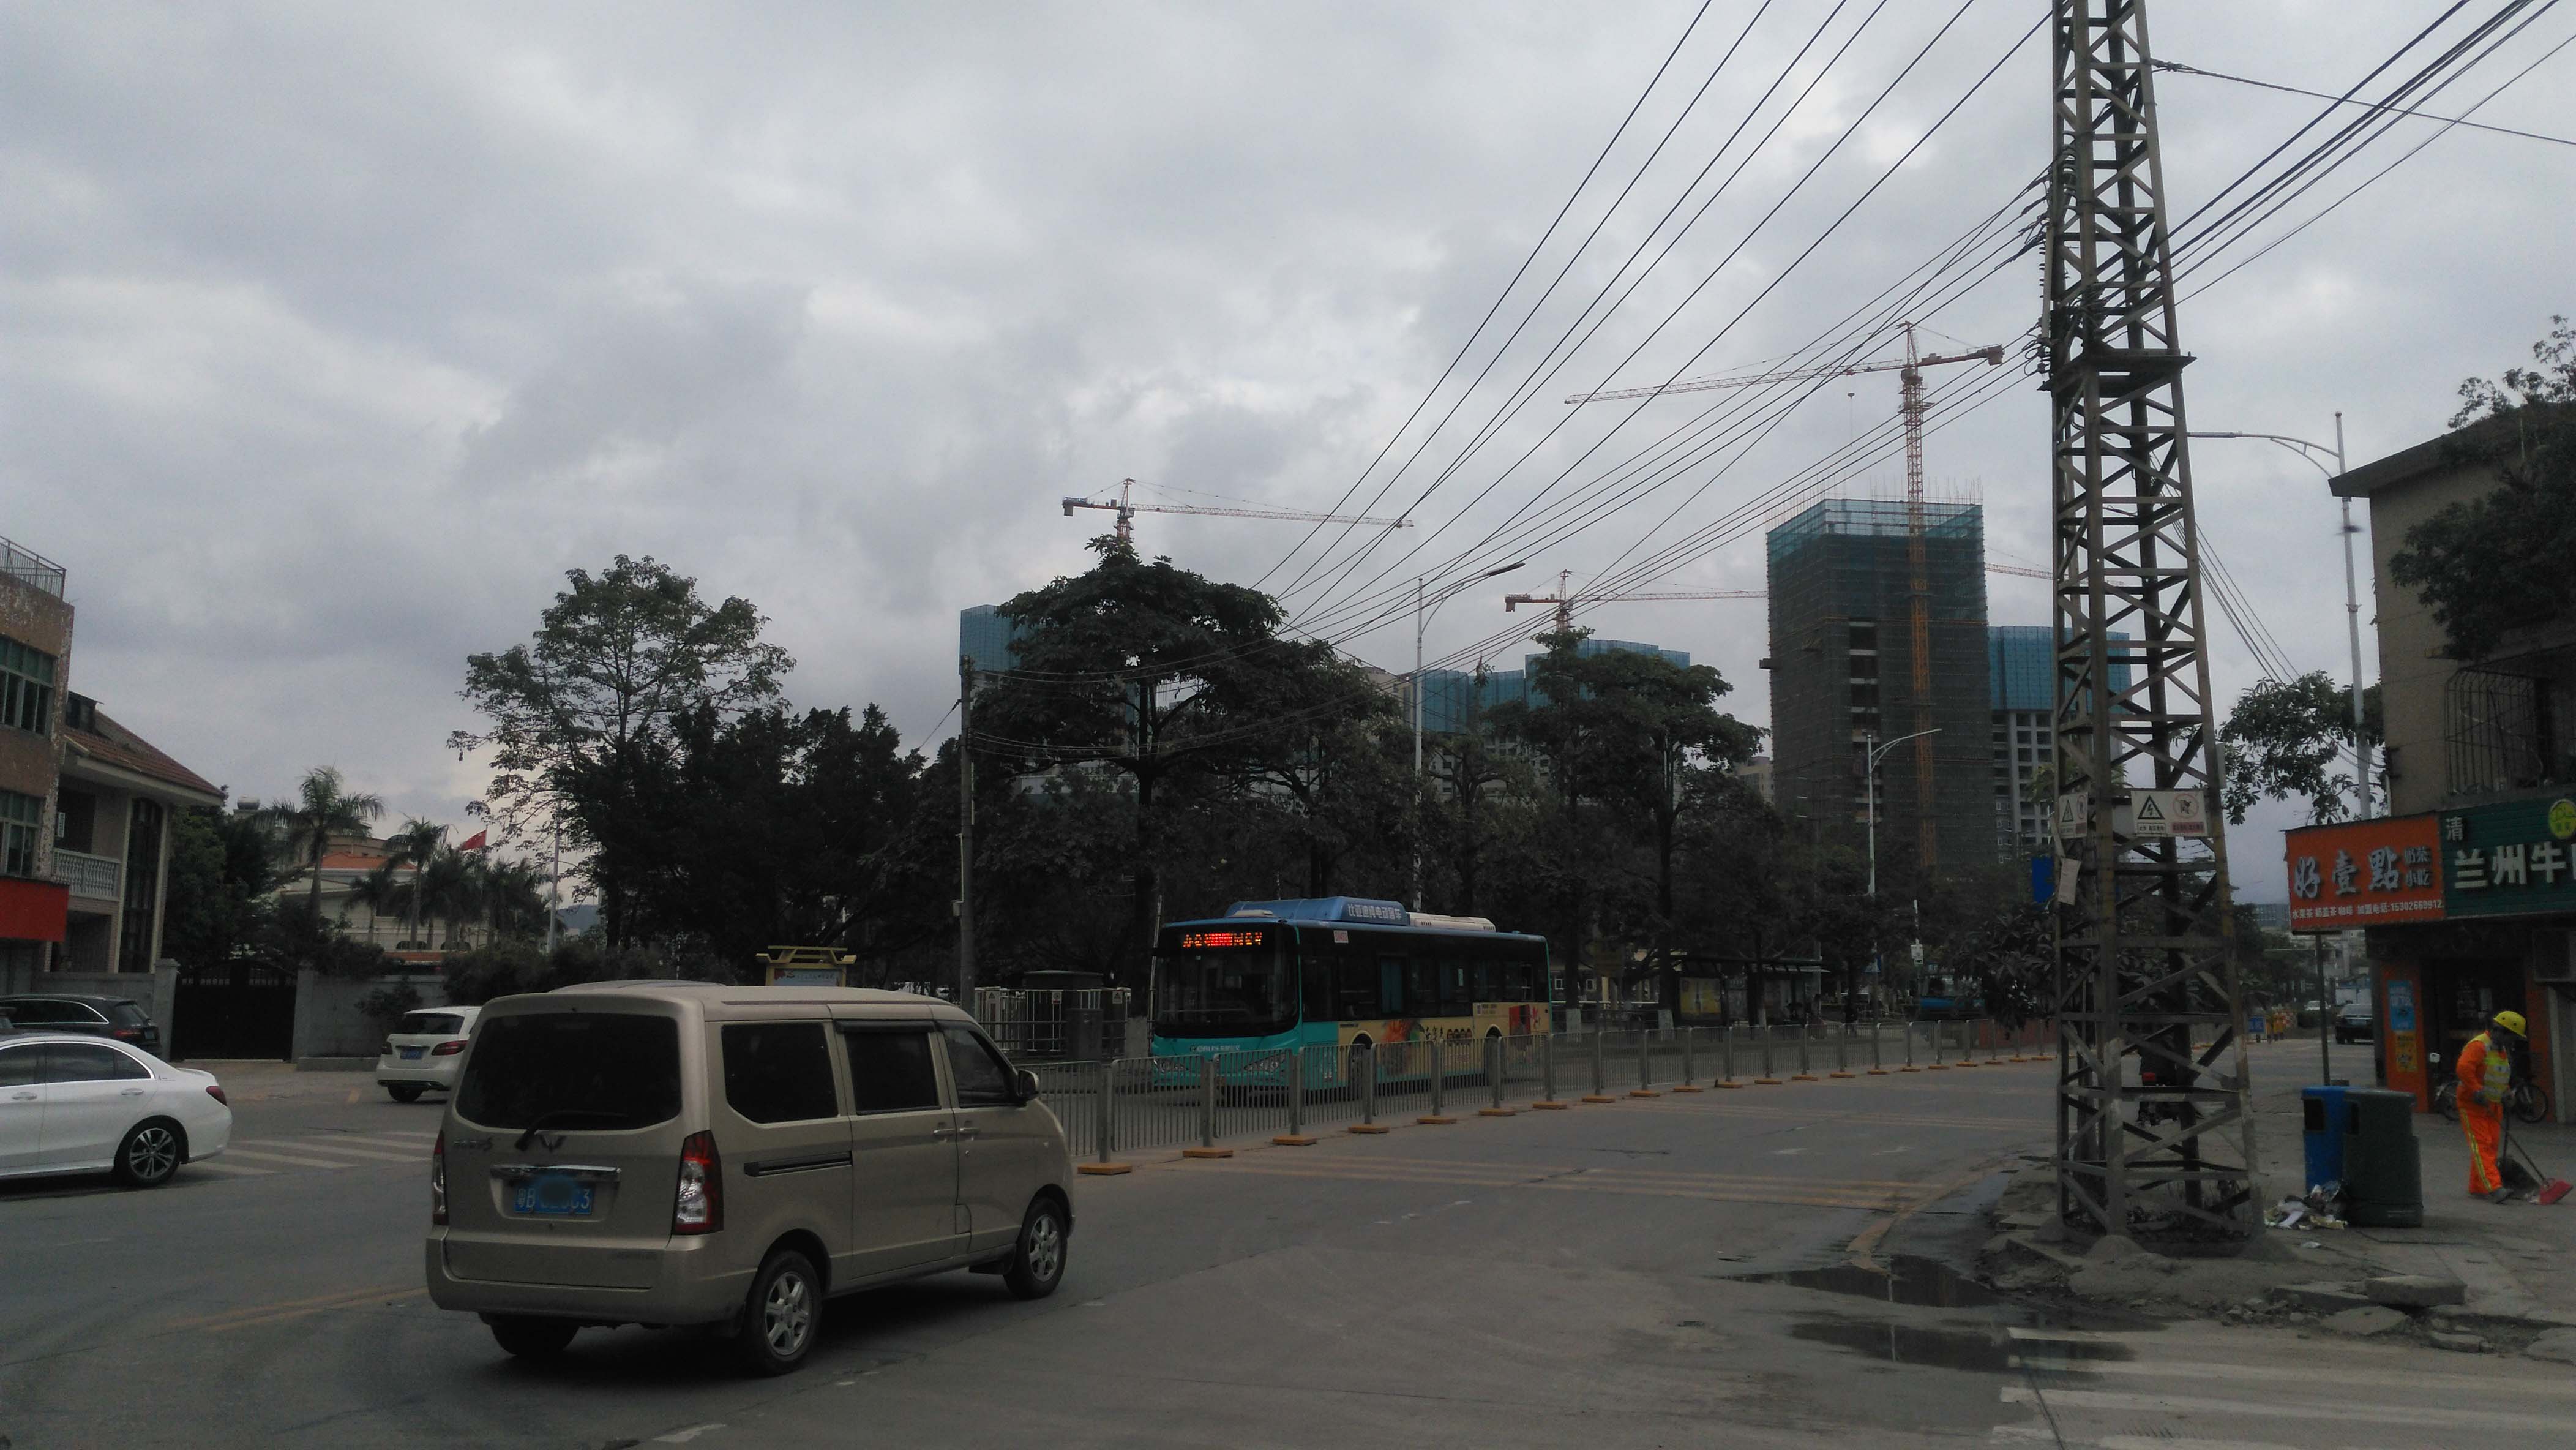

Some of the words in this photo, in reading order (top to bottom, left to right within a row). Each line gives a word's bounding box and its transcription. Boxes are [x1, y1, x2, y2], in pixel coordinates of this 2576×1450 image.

[2446, 816, 2463, 841] 清
[2454, 841, 2576, 888] 兰州牛
